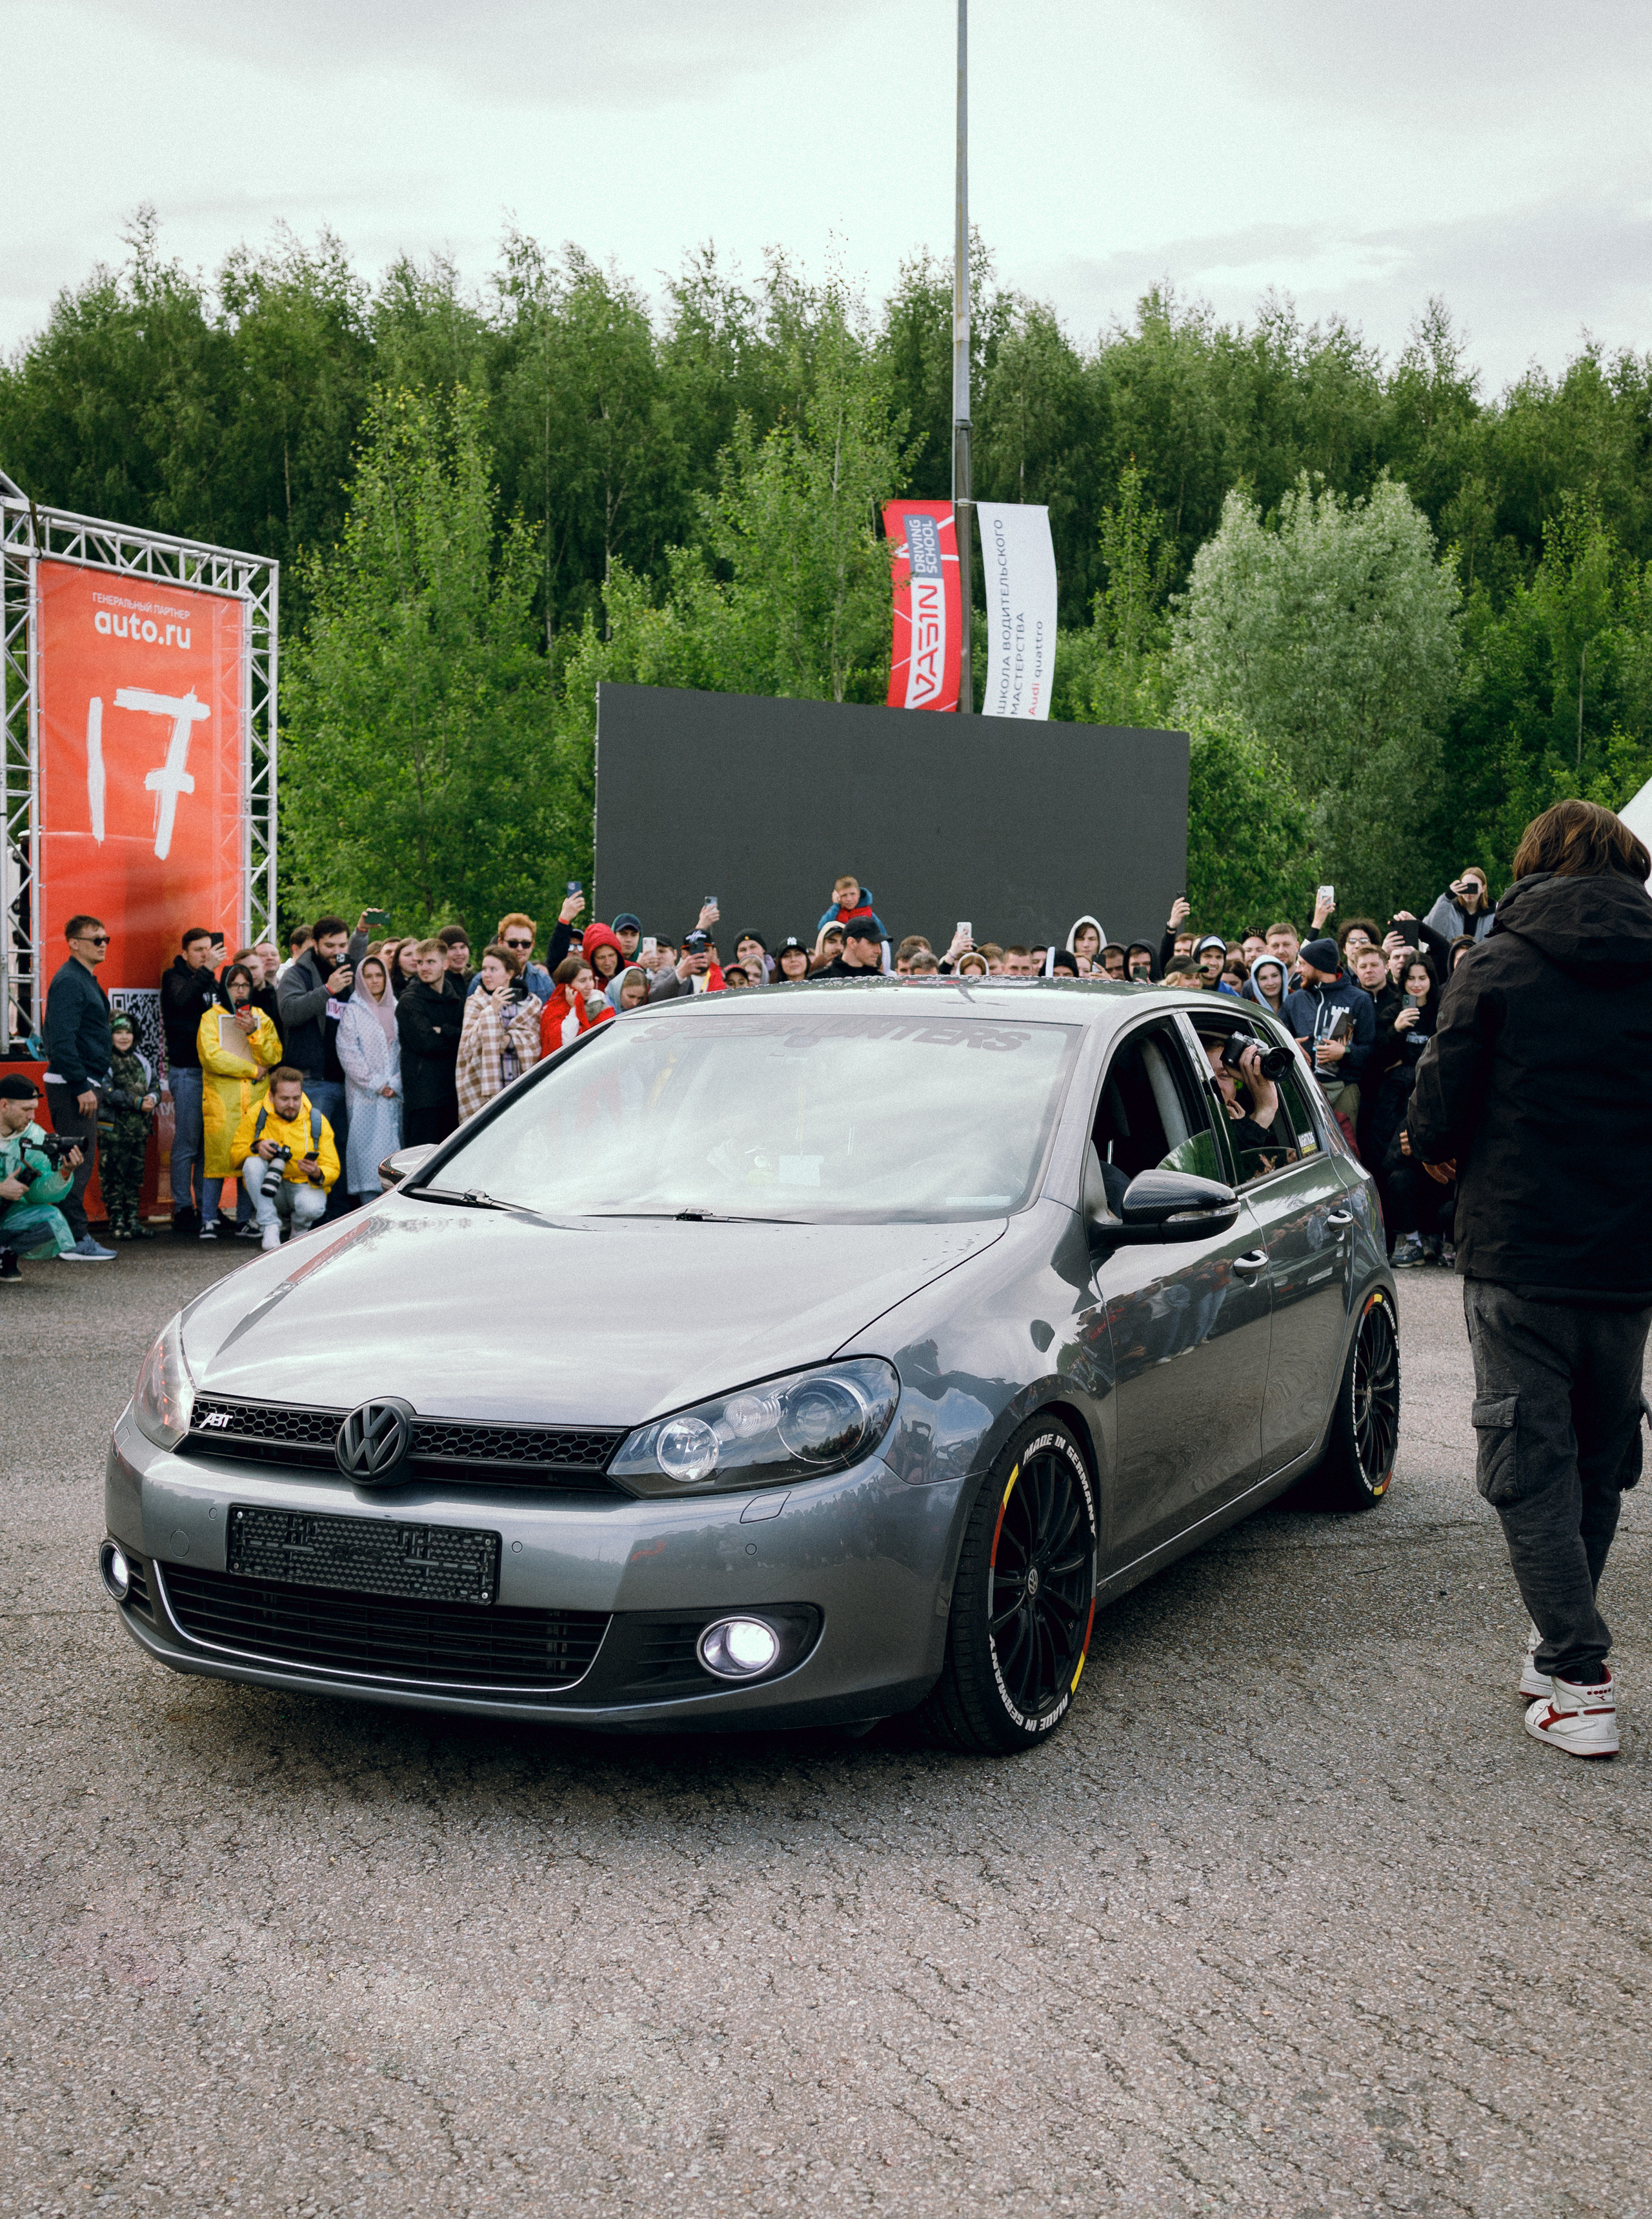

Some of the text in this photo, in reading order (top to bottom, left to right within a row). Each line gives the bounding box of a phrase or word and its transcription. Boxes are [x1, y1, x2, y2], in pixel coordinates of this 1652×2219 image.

[909, 519, 926, 572] DRIVING
[922, 519, 938, 574] SCHOOL
[92, 592, 190, 619] ГЕНЕРАЛЬНЫЙ ПАРТНЕР
[94, 610, 191, 650] auto.ru
[912, 585, 938, 701] VASIN
[994, 519, 1011, 714] ШКОЛА ВОДИТЕЛЬСКОГО
[1011, 612, 1025, 714] МАСТЕРСТВА
[1028, 621, 1043, 716] Audi quattro
[199, 1412, 233, 1429] ABT
[1023, 1434, 1096, 1538] MADE IN GERMANY
[989, 1634, 1068, 1732] MADE IN GERMANY
